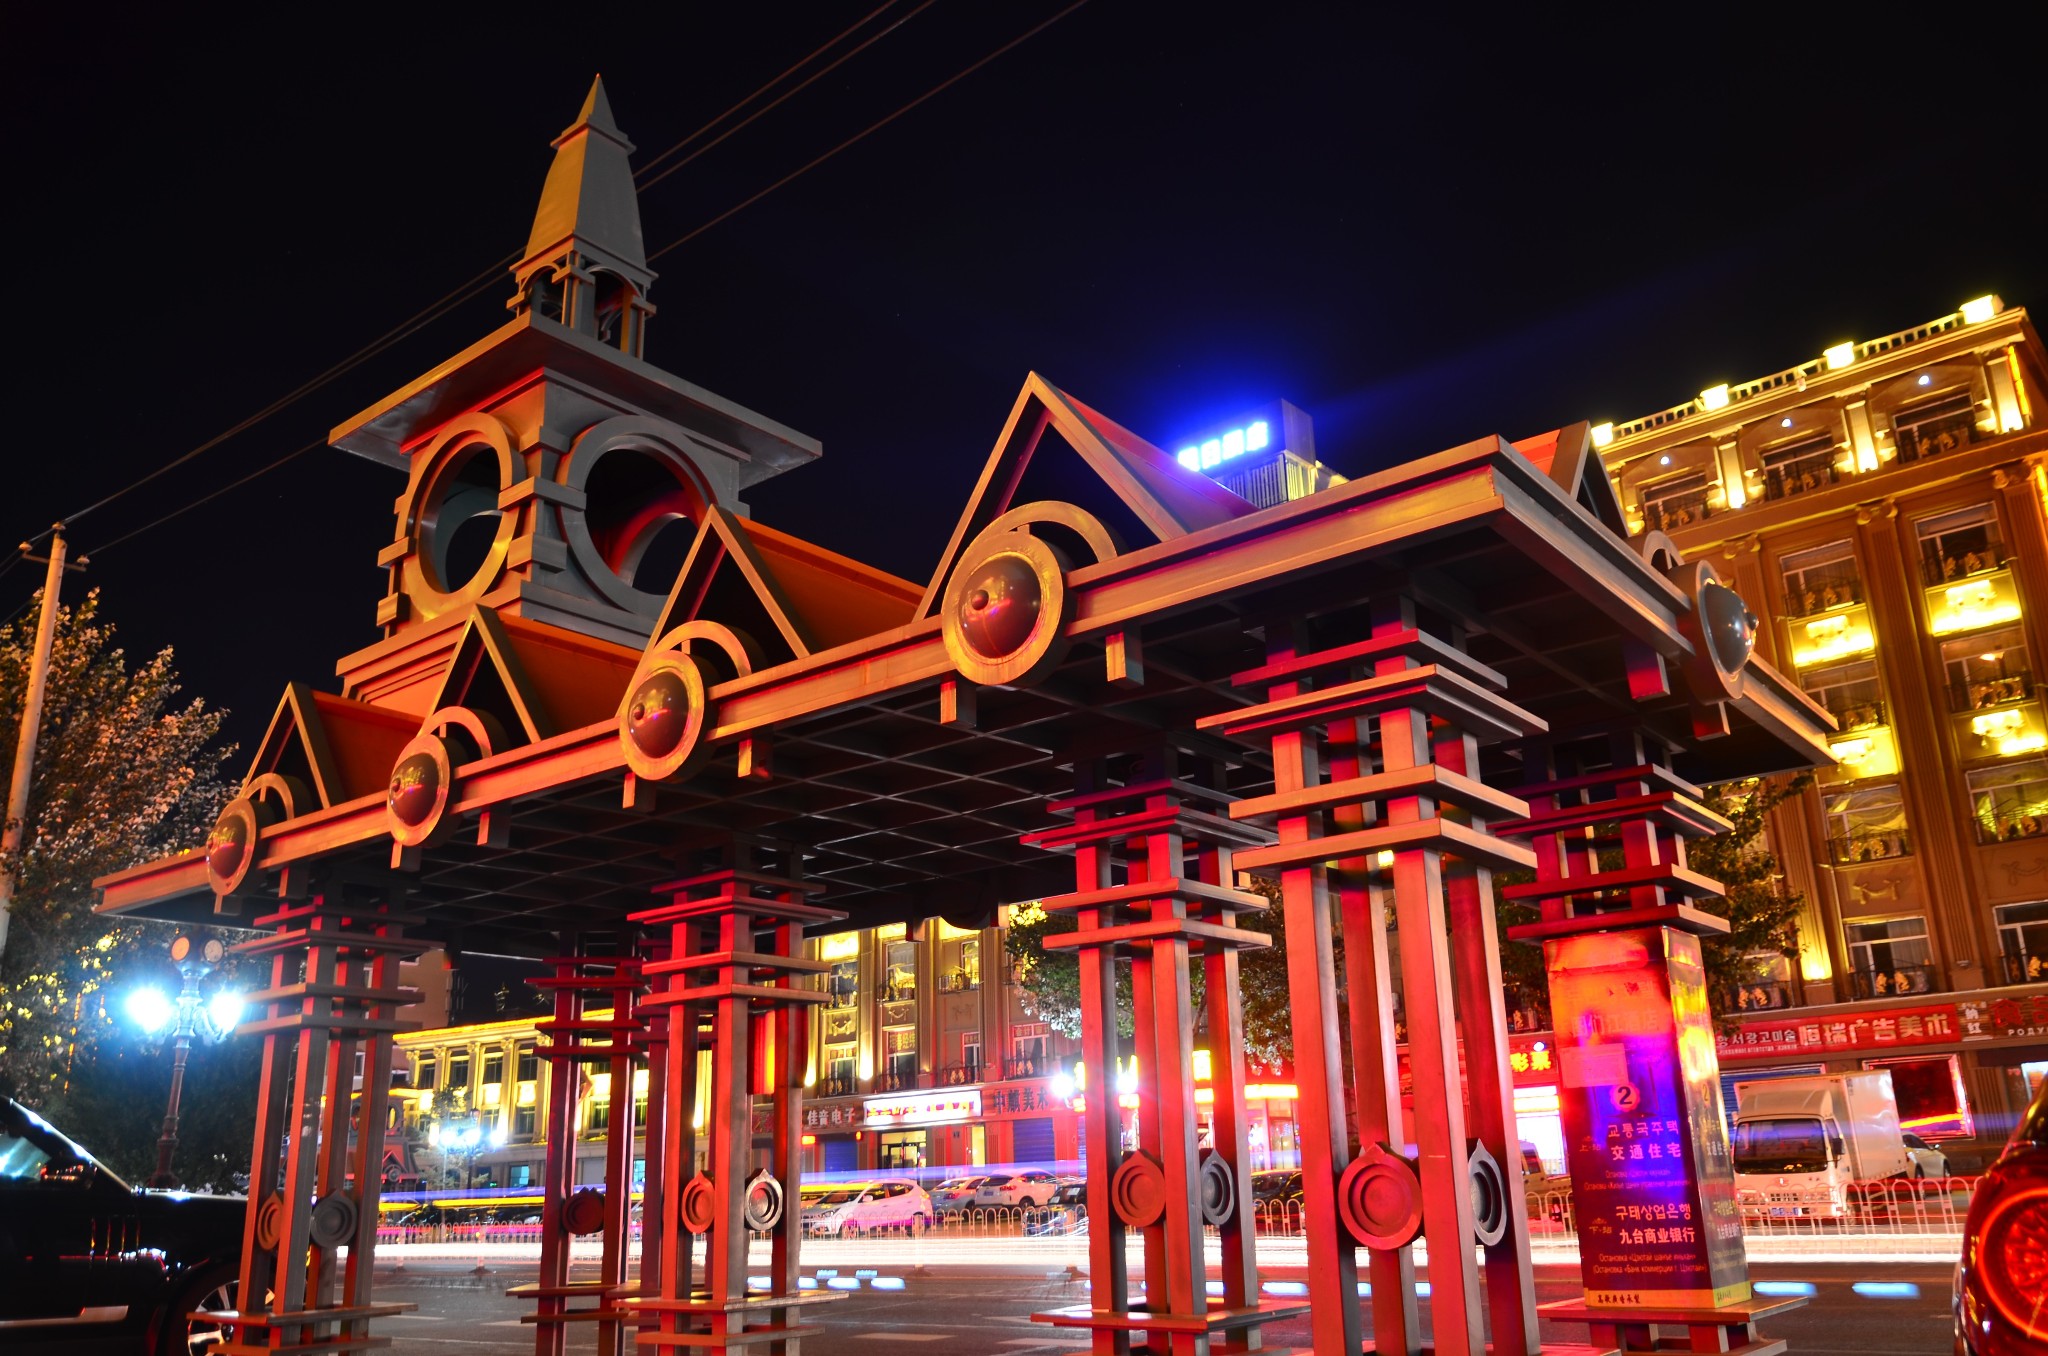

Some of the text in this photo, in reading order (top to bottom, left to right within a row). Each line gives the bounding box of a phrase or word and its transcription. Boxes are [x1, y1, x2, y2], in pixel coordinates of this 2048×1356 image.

[1798, 1013, 1952, 1046] 恒瑞广告美术
[2007, 1027, 2048, 1036] РОДУ
[1617, 1086, 1632, 1105] 2
[807, 1106, 856, 1127] 佳音电子
[1611, 1142, 1682, 1161] 交通住宅
[1615, 1202, 1692, 1222] 구태상업은행
[1619, 1226, 1695, 1244] 九台商业银行
